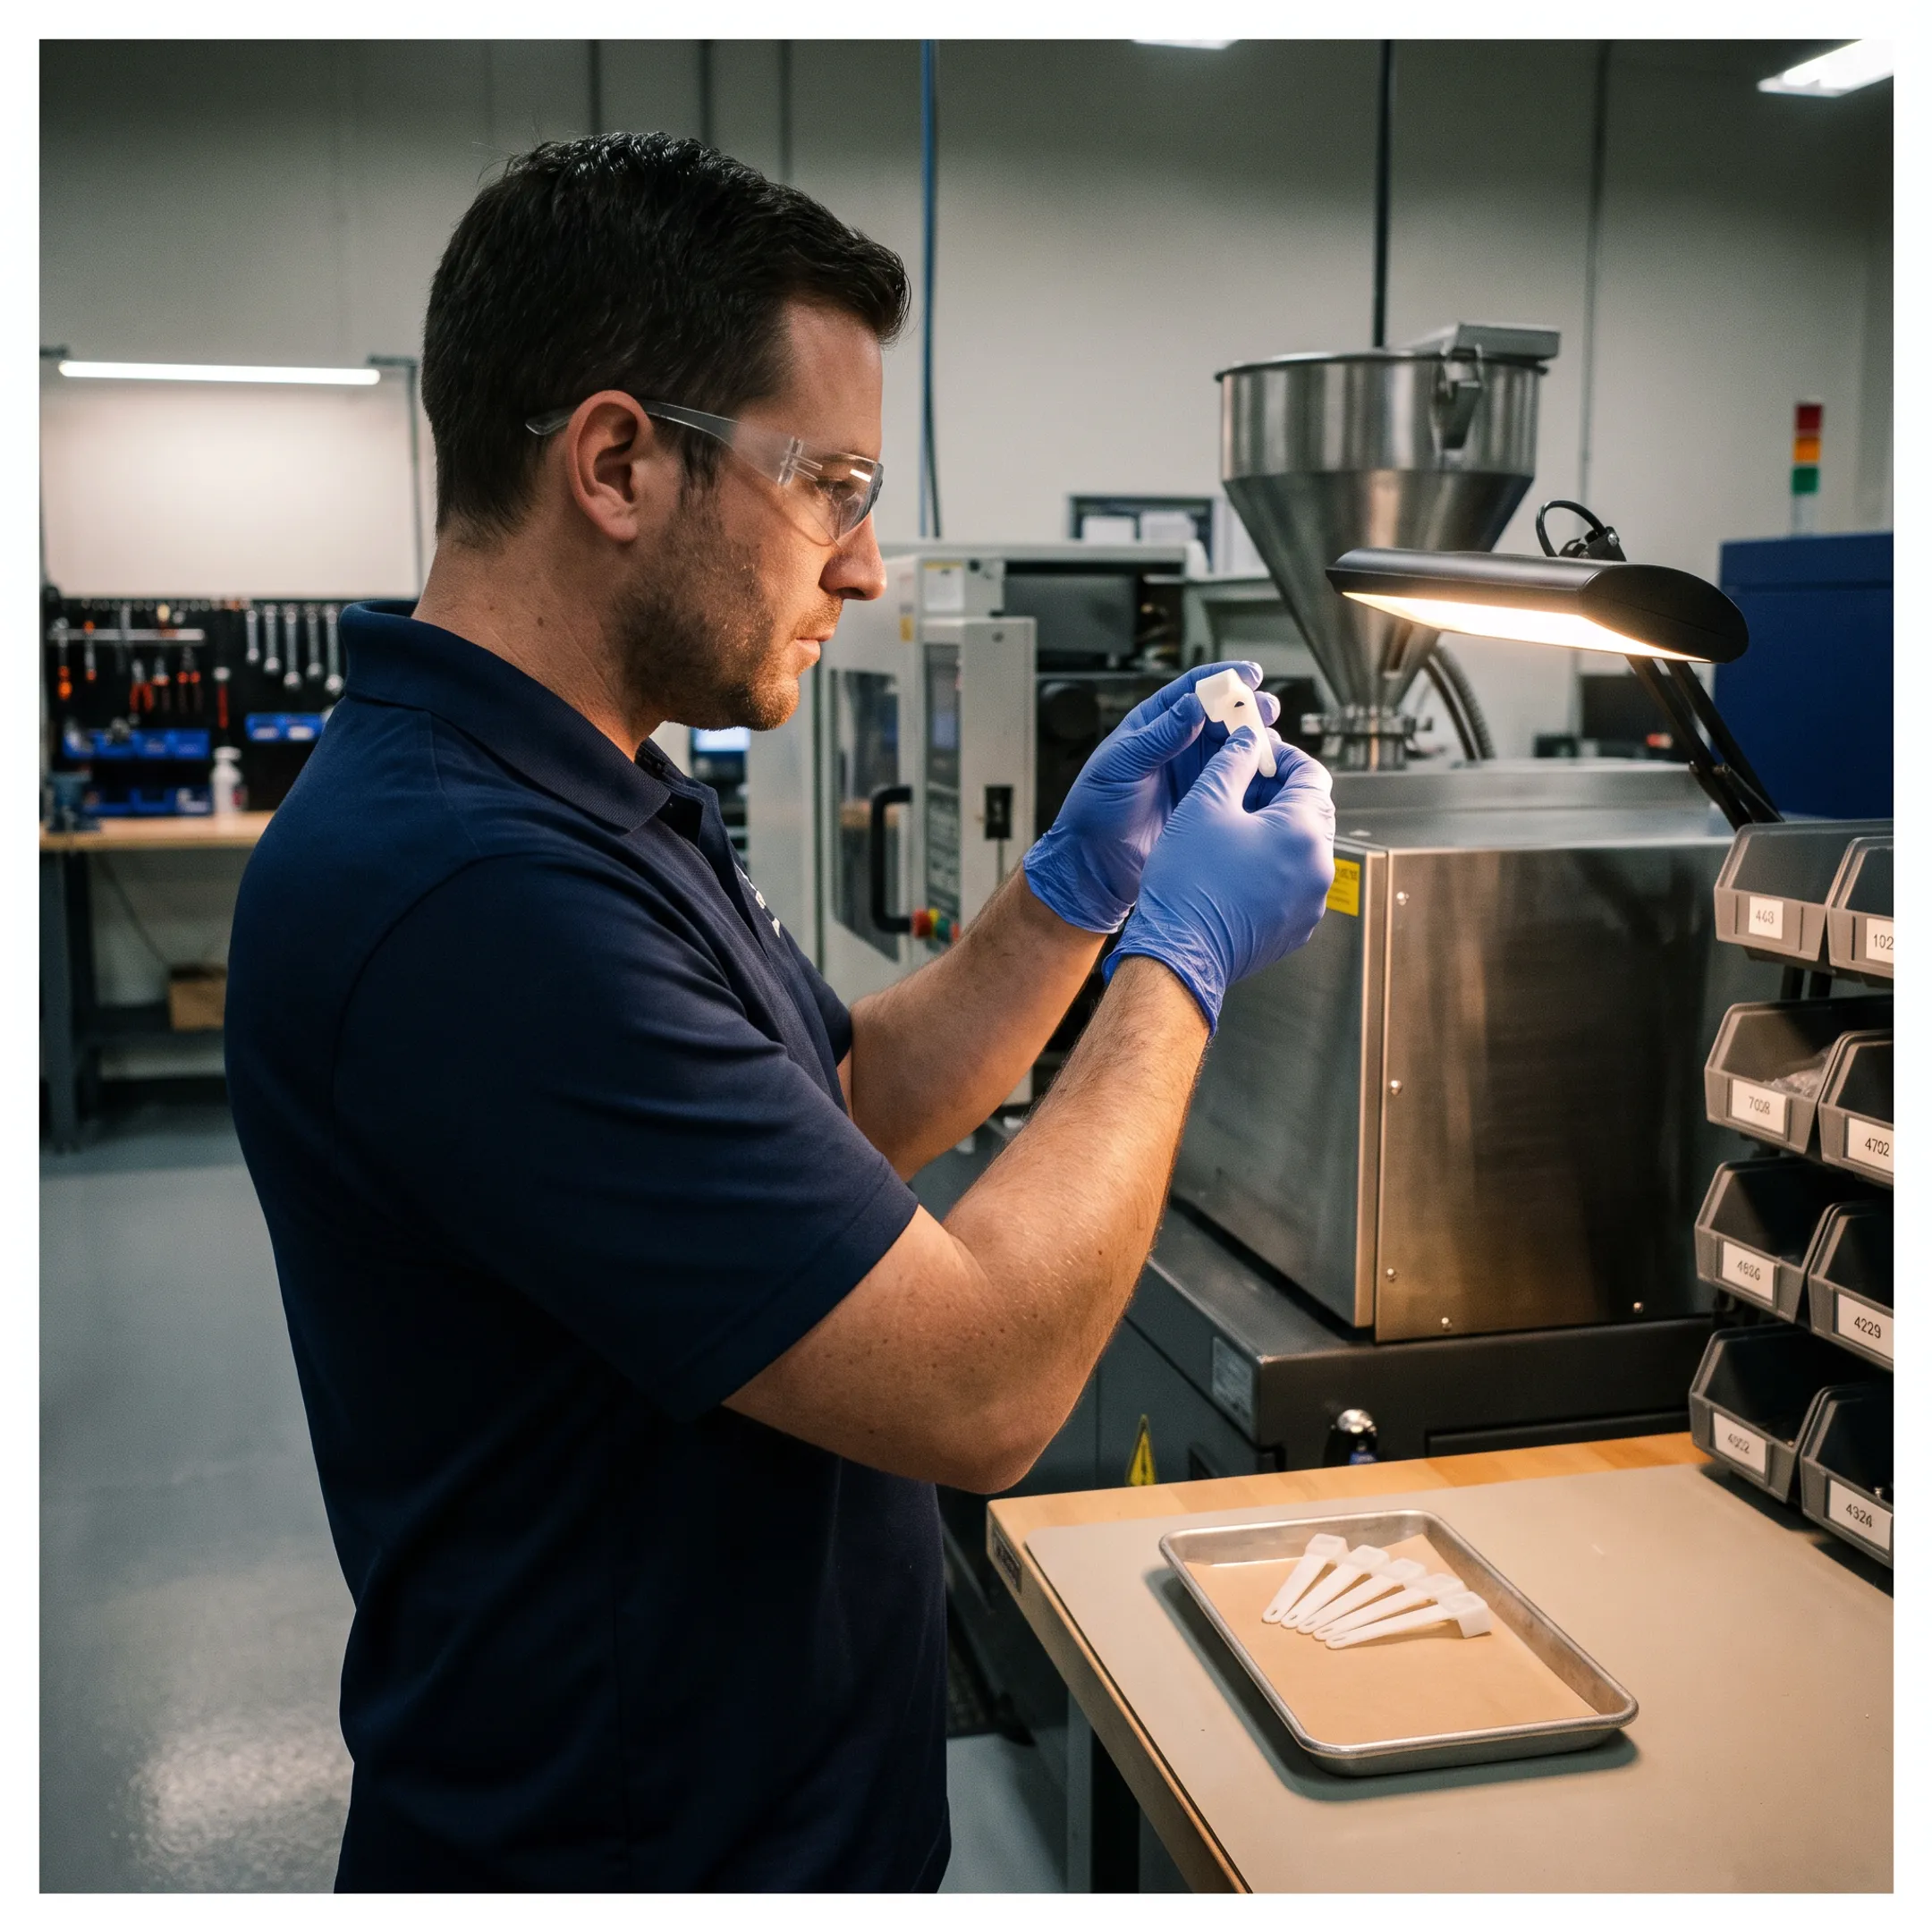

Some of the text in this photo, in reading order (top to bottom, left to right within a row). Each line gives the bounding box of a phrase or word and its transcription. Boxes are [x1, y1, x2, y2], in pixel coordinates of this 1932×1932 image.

[1874, 934, 1894, 951] 102
[1865, 1138, 1890, 1157] 4702
[1854, 1317, 1881, 1339] 4229
